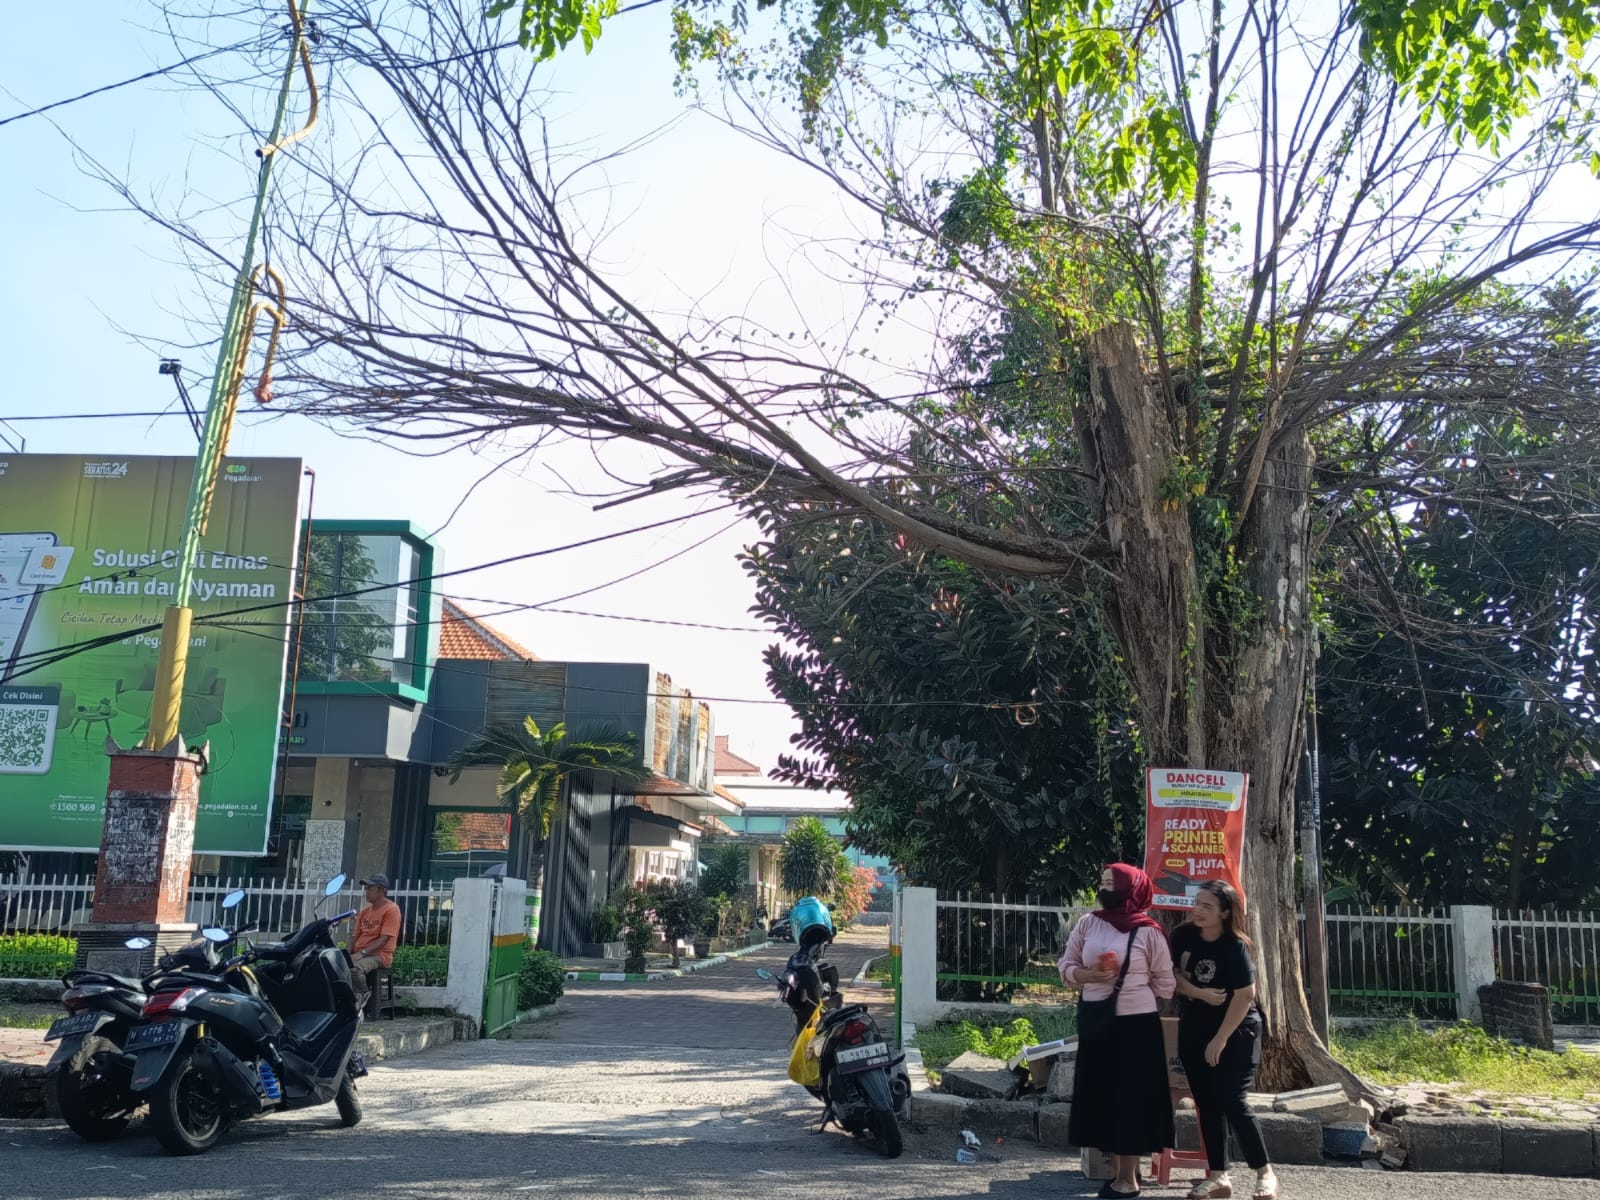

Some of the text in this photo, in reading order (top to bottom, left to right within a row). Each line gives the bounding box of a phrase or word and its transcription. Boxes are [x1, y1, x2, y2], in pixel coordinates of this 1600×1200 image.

[92, 549, 157, 568] Solusi
[211, 551, 268, 570] Emas
[78, 576, 139, 596] Aman
[190, 578, 276, 602] Nyaman
[61, 611, 95, 625] Cicilan
[2, 691, 43, 700] Cek Disini
[1166, 772, 1226, 786] DANCELL
[57, 802, 96, 812] 1500 569
[1164, 818, 1207, 830] READY
[1164, 830, 1225, 844] PRINTER
[1161, 843, 1225, 854] & SCANNER
[1187, 858, 1195, 876] 1
[1195, 858, 1226, 869] JUTA
